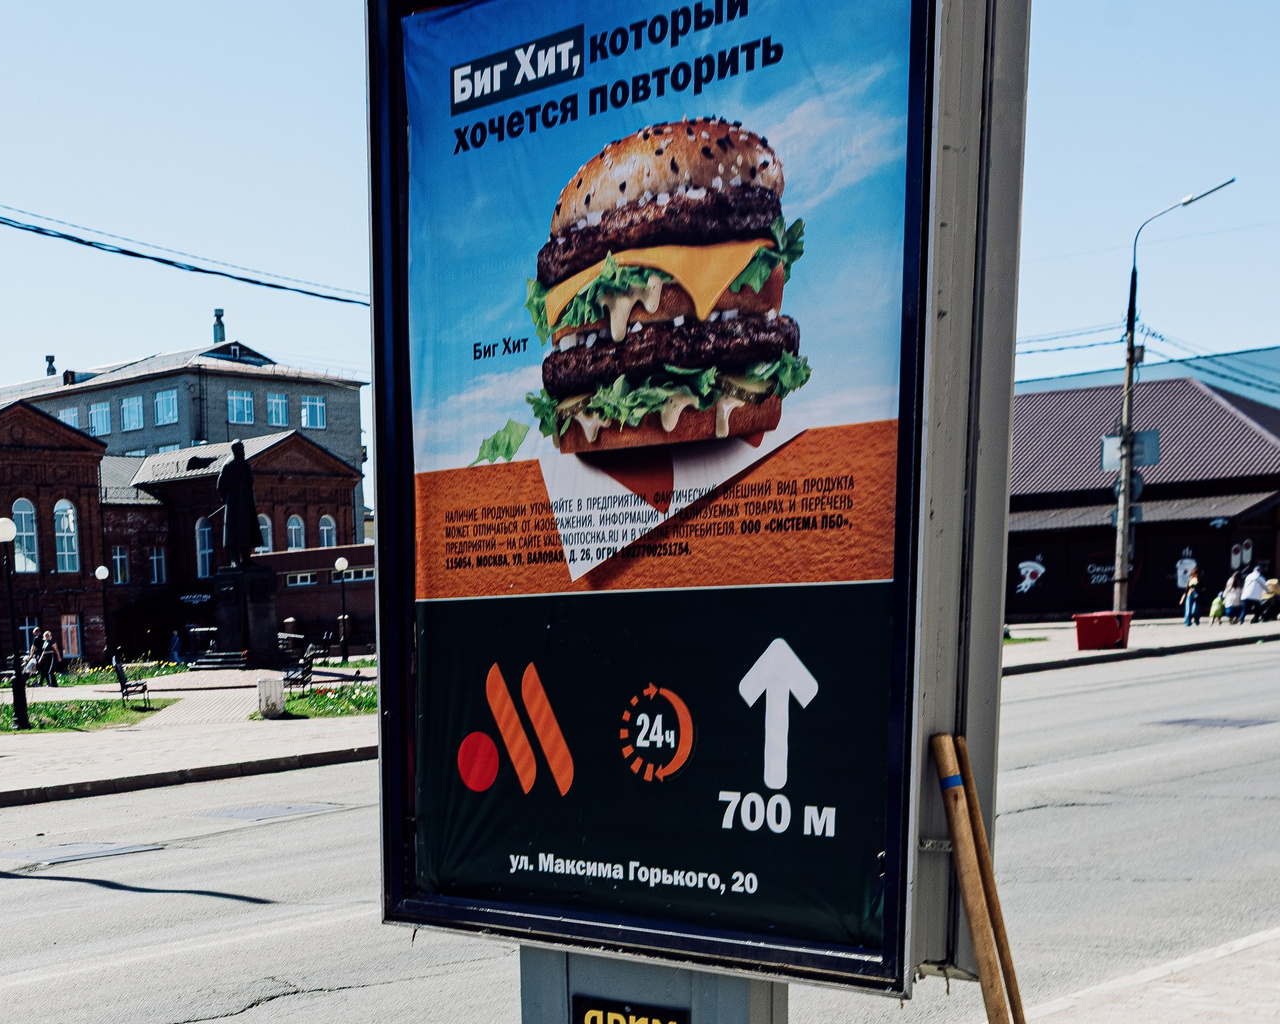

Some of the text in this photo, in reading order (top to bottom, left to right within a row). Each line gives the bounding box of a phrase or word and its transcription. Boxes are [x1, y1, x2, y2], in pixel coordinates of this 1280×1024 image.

[453, 0, 749, 105] Биг Хит, который
[453, 35, 785, 156] хочется повторить
[473, 336, 529, 361] Биг Хит
[445, 508, 478, 523] НАЛИЧИЕ
[481, 504, 527, 521] ПРОДУКЦИИ
[530, 497, 574, 516] УТОЧНЯЙТЕ
[577, 499, 583, 511] В
[653, 483, 718, 504] ФАКТИЧЕСКИЙ
[723, 480, 771, 500] ВНЕШНИЙ
[777, 481, 798, 496] ВИД
[803, 475, 855, 495] ПРОДУКТА
[445, 524, 470, 539] МОЖЕТ
[473, 520, 518, 538] ОТЛИЧАТЬСЯ
[521, 520, 531, 533] ОТ
[534, 514, 595, 532] ИЗОБРАЖЕНИЯ.
[599, 507, 659, 527] ИНФОРМАЦИЯ
[674, 502, 740, 521] РЕАЛИЗУЕМЫХ
[743, 499, 784, 516] ТОВАРАХ
[789, 499, 796, 512] И
[801, 494, 854, 513] ПЕРЕЧЕНЬ
[445, 535, 496, 555] ПРЕДПРИЯТИЙ
[506, 538, 517, 550] НА
[519, 533, 541, 549] САЙТЕ
[622, 530, 628, 542] И
[631, 527, 636, 540] В
[672, 520, 737, 539] ПОТРЕБИТЕЛЯ.
[741, 519, 761, 535] ООО
[764, 516, 817, 532] «СИСТЕМА
[821, 514, 853, 531] ПБО»,
[446, 556, 475, 571] 115054,
[476, 554, 510, 568] МОСКВА,
[512, 553, 525, 567] УЛ.
[527, 550, 567, 566] ВАЛОВАЯ,
[569, 549, 578, 565] Д.
[580, 549, 594, 563] 26,
[718, 790, 792, 833] 700
[509, 852, 759, 895] ул. Максима Горького, 20
